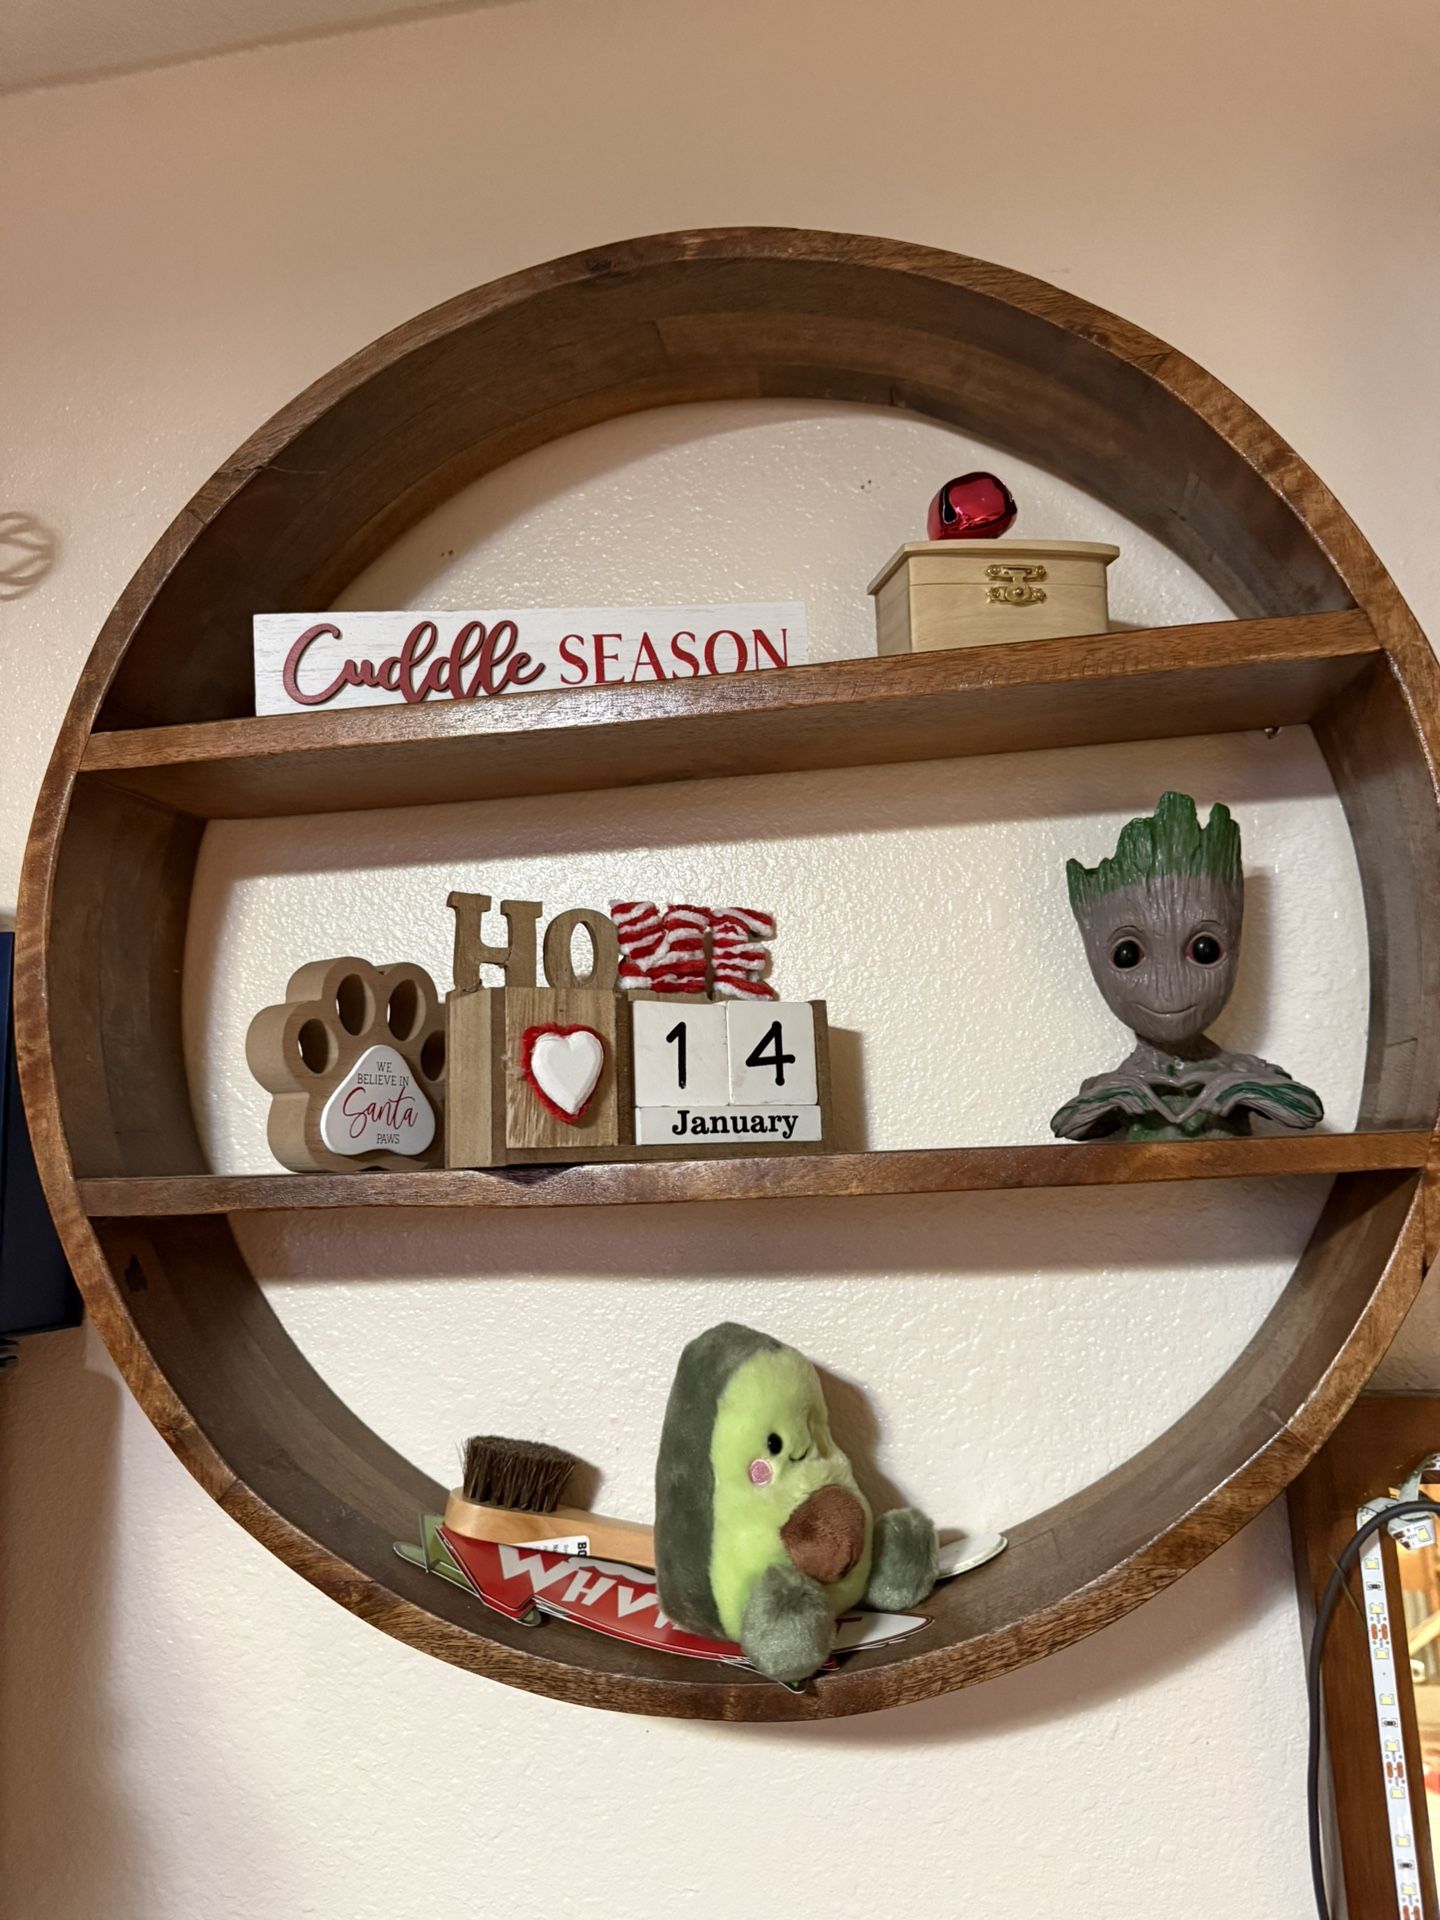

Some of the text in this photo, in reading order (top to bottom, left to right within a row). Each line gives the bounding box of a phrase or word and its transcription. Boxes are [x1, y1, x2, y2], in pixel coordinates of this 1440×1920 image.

[282, 619, 788, 705] Cuddle SEASON
[376, 1061, 393, 1073] WE
[357, 1073, 410, 1087] BELIEVE IN
[342, 1086, 418, 1139] Santa
[671, 1110, 799, 1140] January
[376, 1133, 400, 1145] PAWS
